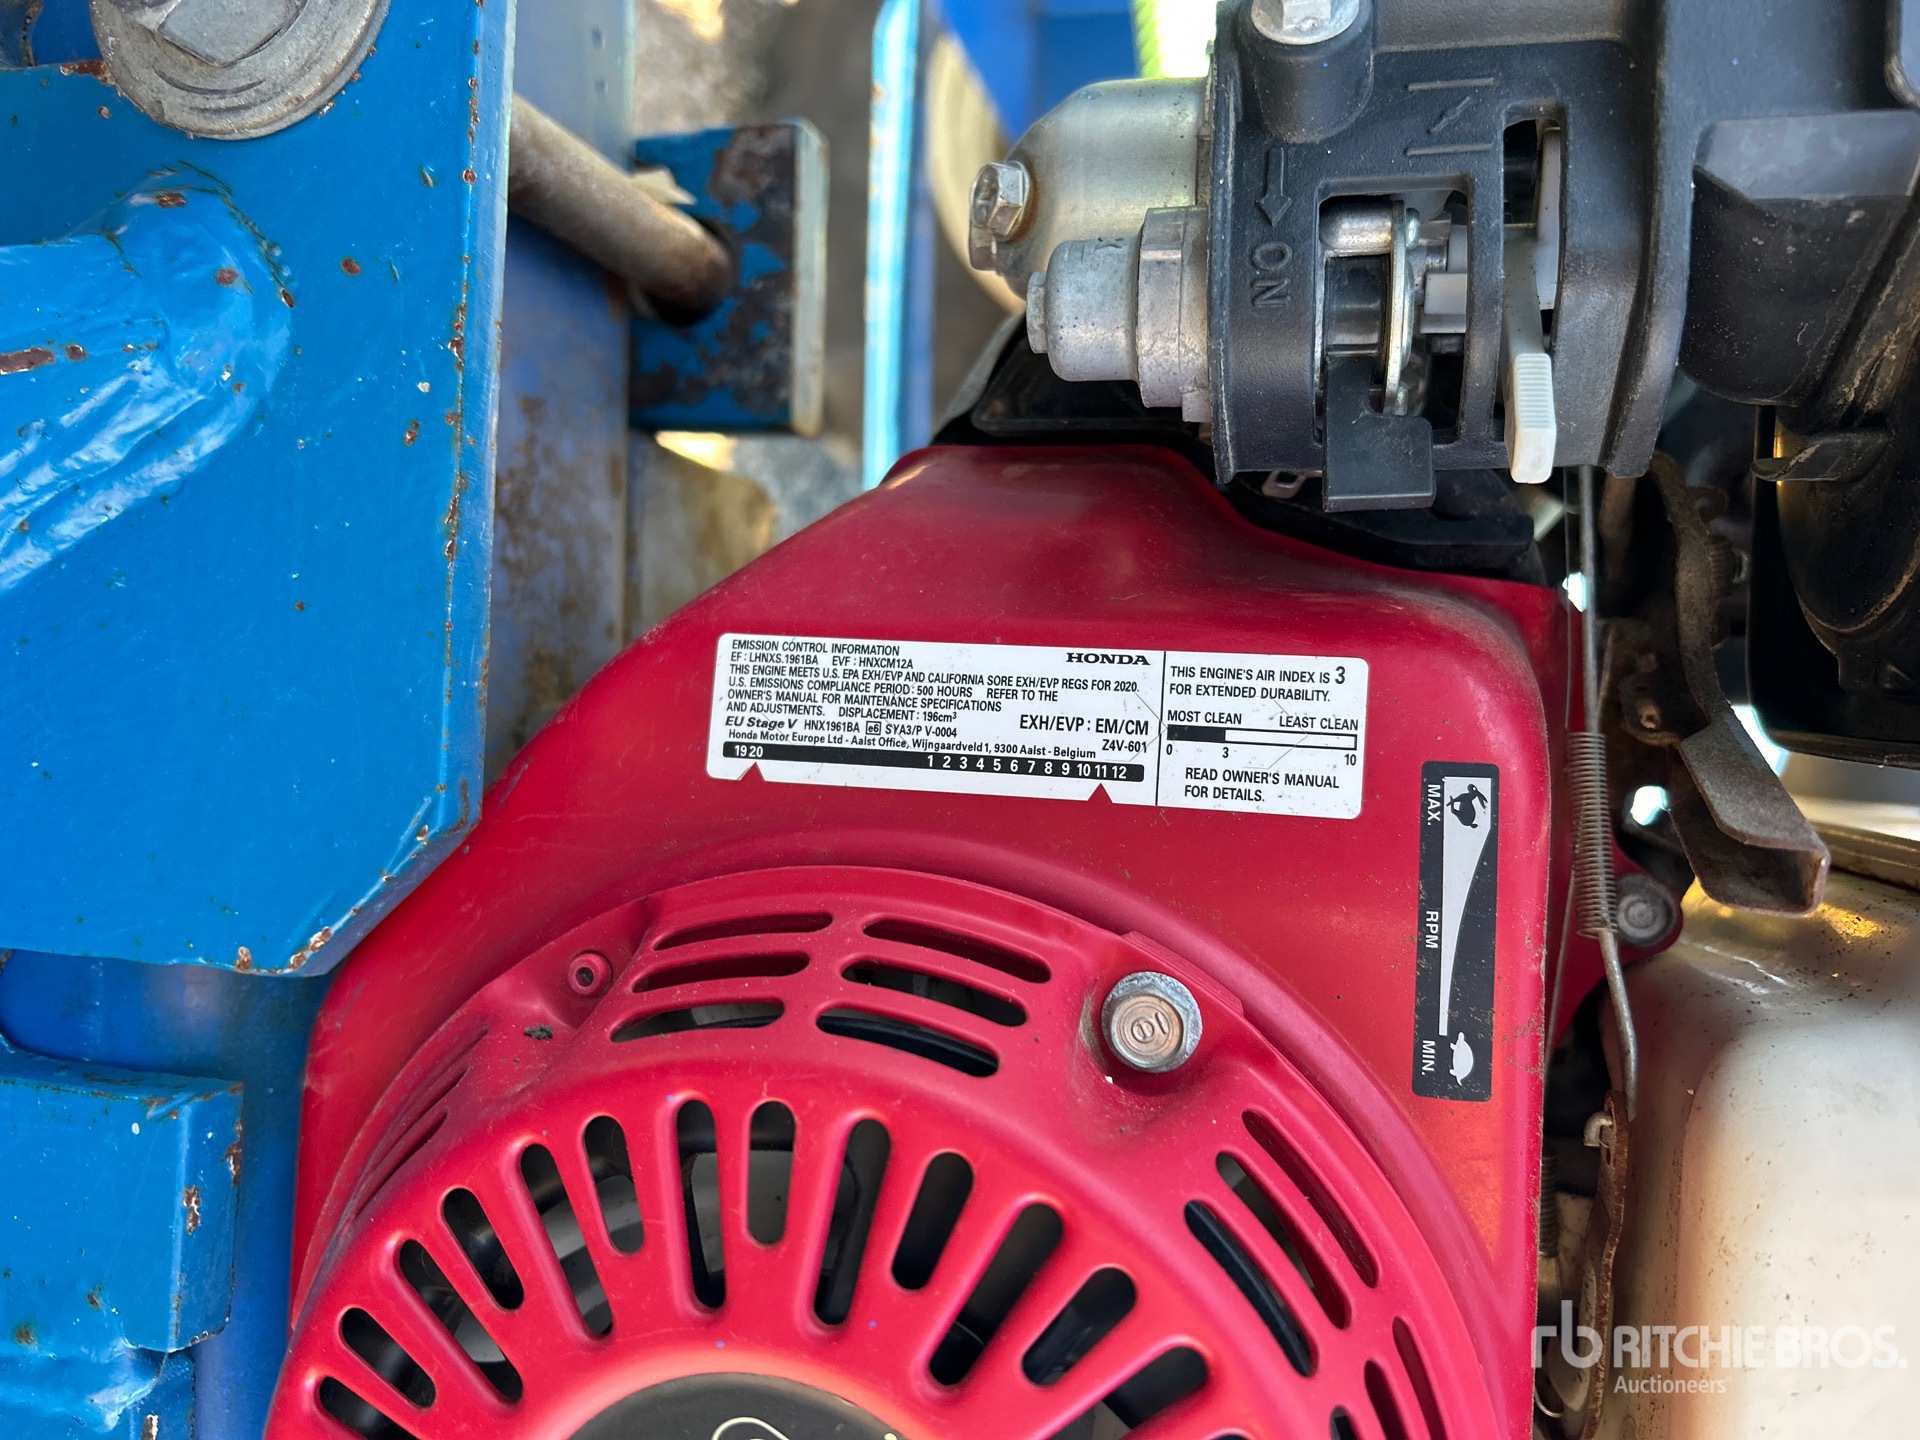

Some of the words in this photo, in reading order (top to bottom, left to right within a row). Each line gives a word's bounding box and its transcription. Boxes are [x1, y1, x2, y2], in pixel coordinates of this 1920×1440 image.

[731, 639, 779, 651] EMISSION
[781, 640, 828, 653] CONTROL
[831, 642, 900, 656] INFORMATION
[748, 652, 819, 665] LHNXS.1961BA
[858, 656, 914, 669] HNXCM12A
[1065, 651, 1151, 666] HONDA
[729, 663, 750, 675] THIS
[751, 664, 787, 676] ENGINE
[788, 665, 820, 678] MEETS
[822, 667, 840, 679] U.S.
[842, 668, 859, 680] EPA
[861, 668, 903, 681] EXH/EVP
[903, 671, 926, 683] AND
[927, 672, 985, 686] CALIFORNIA
[986, 674, 1014, 687] SORE
[1015, 675, 1060, 689] EXH/EVP
[1061, 677, 1089, 690] REGS
[1090, 679, 1112, 691] FOR
[1113, 680, 1139, 693] 2020.
[1170, 665, 1196, 678] THIS
[1199, 666, 1253, 681] ENGINE'S
[1255, 669, 1275, 682] AIR
[1278, 670, 1315, 683] INDEX
[1319, 671, 1330, 684] IS
[1334, 665, 1346, 685] 3
[728, 676, 748, 687] U.S.
[749, 676, 804, 690] EMISSIONS
[806, 679, 871, 693] COMPLIANCE
[916, 684, 934, 696] 500
[936, 685, 973, 698] HOURS
[986, 687, 1019, 700] REFER
[1020, 689, 1035, 701] TO
[1037, 690, 1058, 702] THE
[1169, 682, 1192, 695] FOR
[1195, 684, 1257, 699] EXTENDED
[1260, 686, 1330, 702] DURABILITY.
[726, 701, 747, 712] AND
[749, 702, 825, 716] ADJUSTMENTS.
[727, 688, 772, 701] OWNER'S
[775, 690, 818, 703] MANUAL
[821, 692, 841, 704] FOR
[843, 693, 918, 708] MAINTENANCE
[919, 697, 1002, 712] SPECIFICATIONS
[724, 715, 745, 727] EU
[746, 716, 785, 730] Stage
[787, 718, 798, 729] V
[803, 719, 860, 733] HNX1961BA
[866, 723, 880, 735] e6
[884, 722, 923, 736] SYA3/P
[924, 725, 957, 738] V-0004
[1095, 717, 1149, 736] EM/CM
[1166, 709, 1201, 723] MOST
[1203, 711, 1242, 725] CLEAN
[1279, 715, 1317, 729] LEAST
[1319, 717, 1358, 731] CLEAN
[728, 728, 758, 740] Honda
[759, 728, 790, 742] Motor
[791, 731, 825, 745] Europe
[827, 733, 843, 744] Ltd
[850, 734, 876, 746] Aalst
[877, 736, 910, 749] Office,
[993, 743, 1018, 754] 9300
[1019, 744, 1046, 756] Aalst
[1053, 745, 1096, 759] Belgium
[1101, 738, 1147, 754] Z4V-601
[1165, 743, 1173, 756] 0
[1221, 746, 1229, 759] 3
[1344, 753, 1357, 766] 10
[927, 754, 933, 767] 1
[942, 754, 951, 769] 2
[959, 755, 968, 770] 3
[975, 757, 985, 770] 4
[993, 757, 1001, 771] 5
[1009, 759, 1019, 772] 6
[1027, 759, 1036, 773] 7
[1044, 760, 1053, 774] 8
[1061, 762, 1070, 776] 9
[1076, 763, 1091, 777] 10
[1094, 764, 1107, 778] 11
[1111, 765, 1127, 779] 12
[1185, 766, 1218, 781] READ
[1222, 769, 1280, 785] OWNER'S
[1284, 772, 1340, 789] MANUAL
[1184, 784, 1209, 798] FOR
[1212, 786, 1265, 802] DETAILS.
[1427, 784, 1441, 826] MAX.
[1425, 910, 1439, 949] RPM
[1421, 1040, 1436, 1076] MIN.
